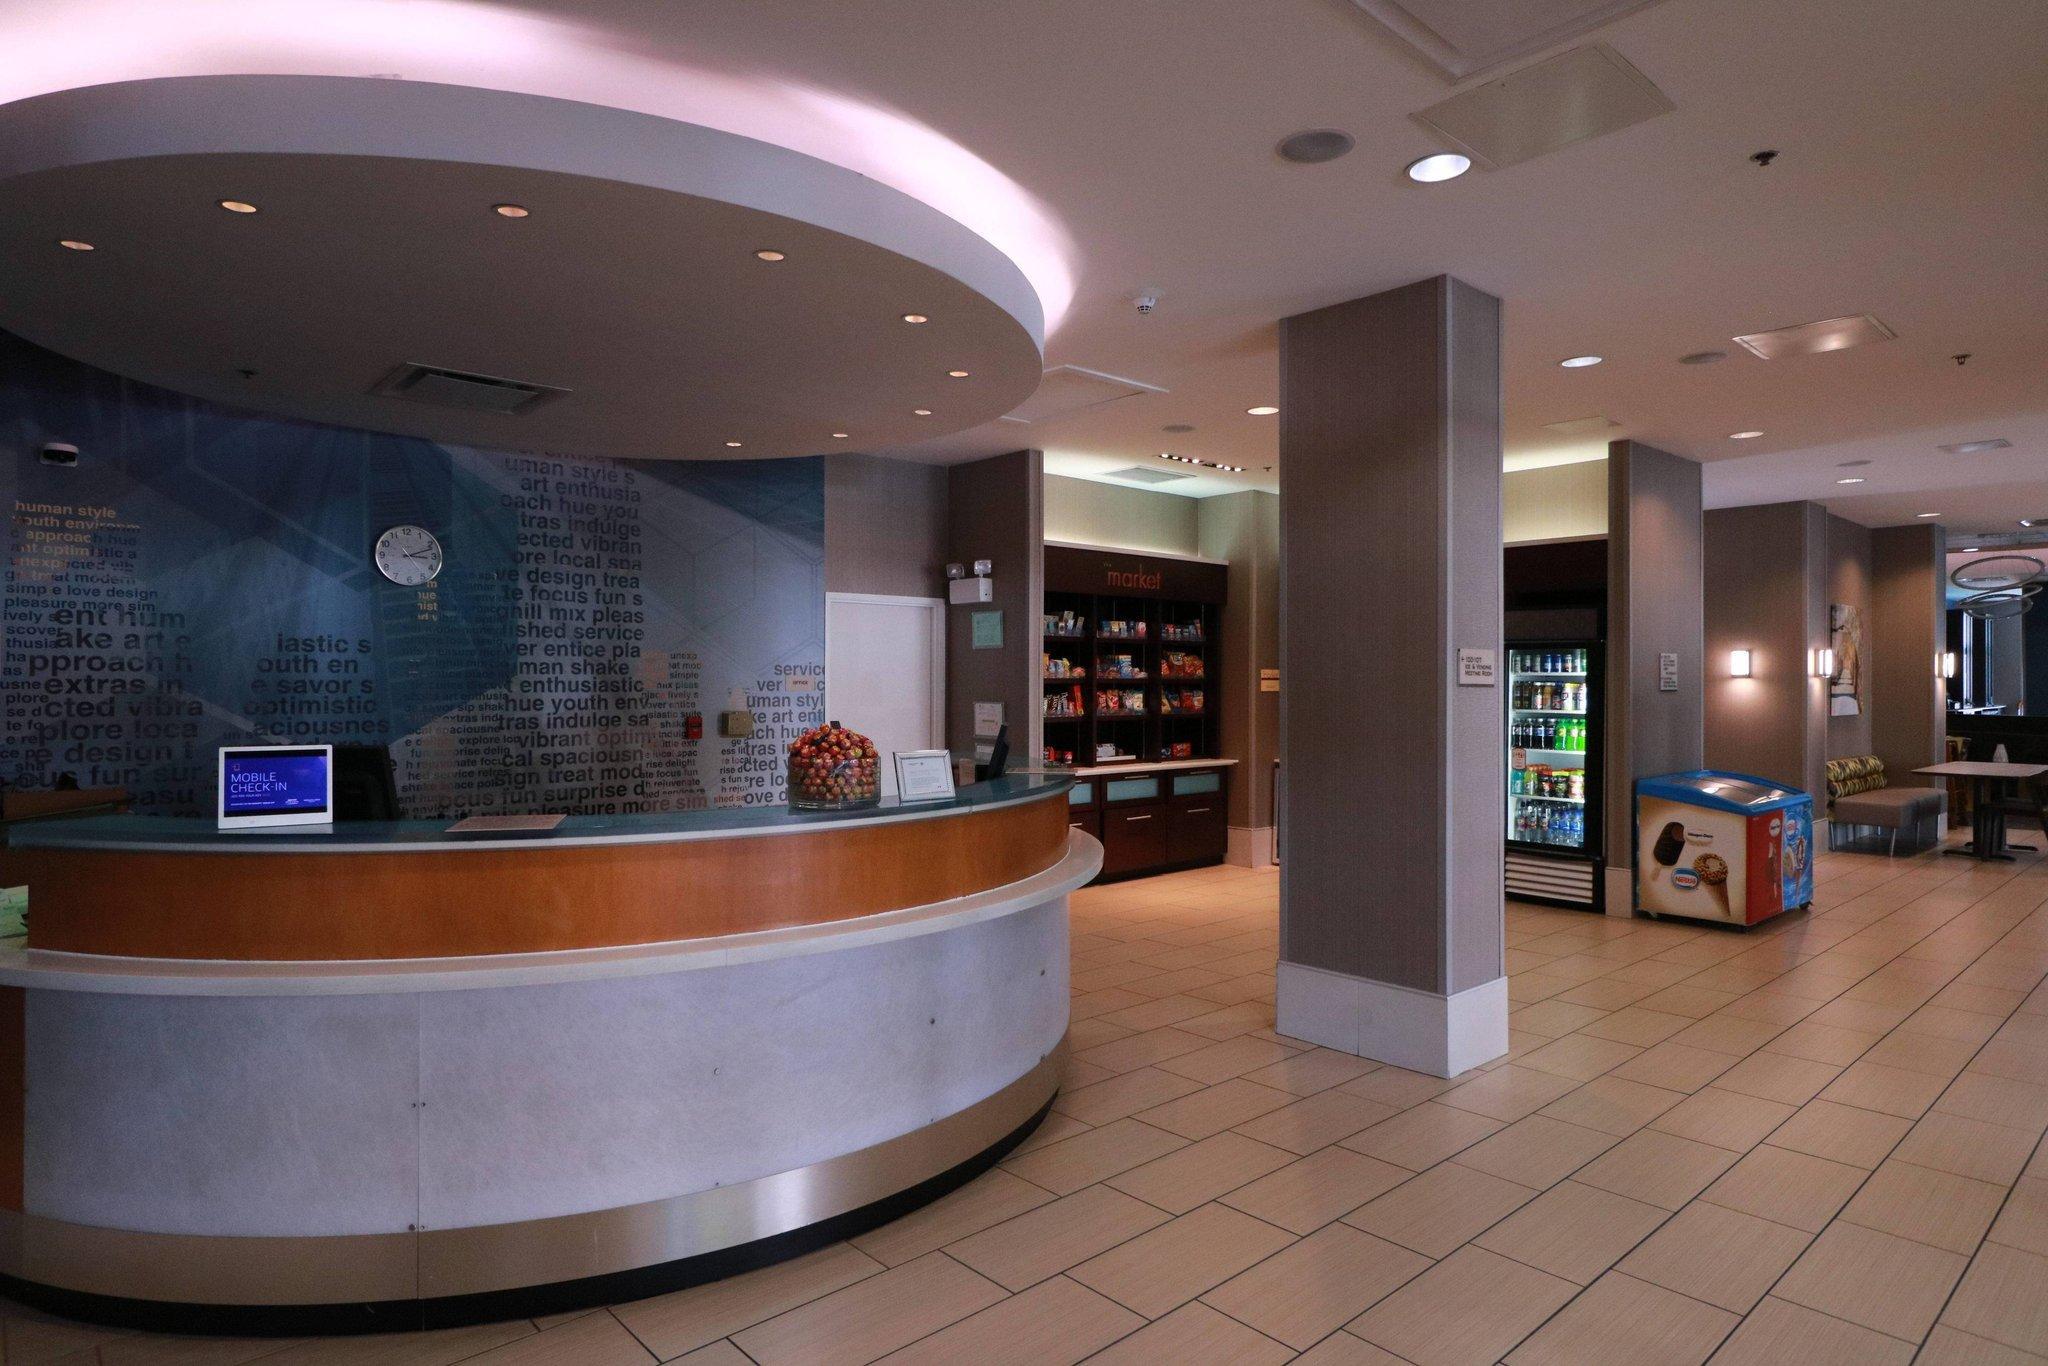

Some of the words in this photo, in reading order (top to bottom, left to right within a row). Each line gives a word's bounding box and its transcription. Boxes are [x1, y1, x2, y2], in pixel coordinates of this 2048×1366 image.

[520, 476, 550, 493] art
[555, 480, 641, 503] enthusia
[15, 499, 72, 516] human
[78, 506, 117, 519] style
[559, 496, 597, 516] hue
[401, 527, 412, 536] 12
[520, 511, 562, 530] tras
[567, 515, 641, 541] indulge
[517, 532, 574, 550] ected
[580, 535, 642, 555] vibran
[553, 549, 601, 570] local
[526, 567, 597, 590] design
[603, 572, 640, 590] trea
[1107, 563, 1162, 590] market
[67, 585, 101, 597] love
[105, 586, 159, 601] design
[530, 584, 588, 604] focus
[594, 588, 626, 605] fun
[592, 606, 644, 626] pleas
[516, 621, 567, 639] shed
[573, 624, 645, 641] service
[543, 640, 607, 658] entice
[257, 655, 318, 674] outh
[327, 658, 359, 674] en
[519, 660, 564, 675] man
[570, 659, 630, 676] shake
[44, 675, 146, 695] extras
[277, 679, 352, 694] savor
[520, 676, 645, 694] enthusiastic
[756, 680, 783, 693] ver
[44, 697, 115, 718] cted
[504, 693, 545, 712] hue
[550, 694, 609, 715] youth
[546, 712, 622, 731] indulge
[772, 709, 794, 724] art
[519, 730, 591, 749] vibrant
[745, 742, 776, 757] tras
[743, 756, 778, 773] cted
[230, 771, 278, 784] MOBILE
[548, 765, 594, 784] treat
[230, 781, 288, 794] CHECK-IN
[543, 781, 628, 803] surprise
[744, 790, 774, 805] ove
